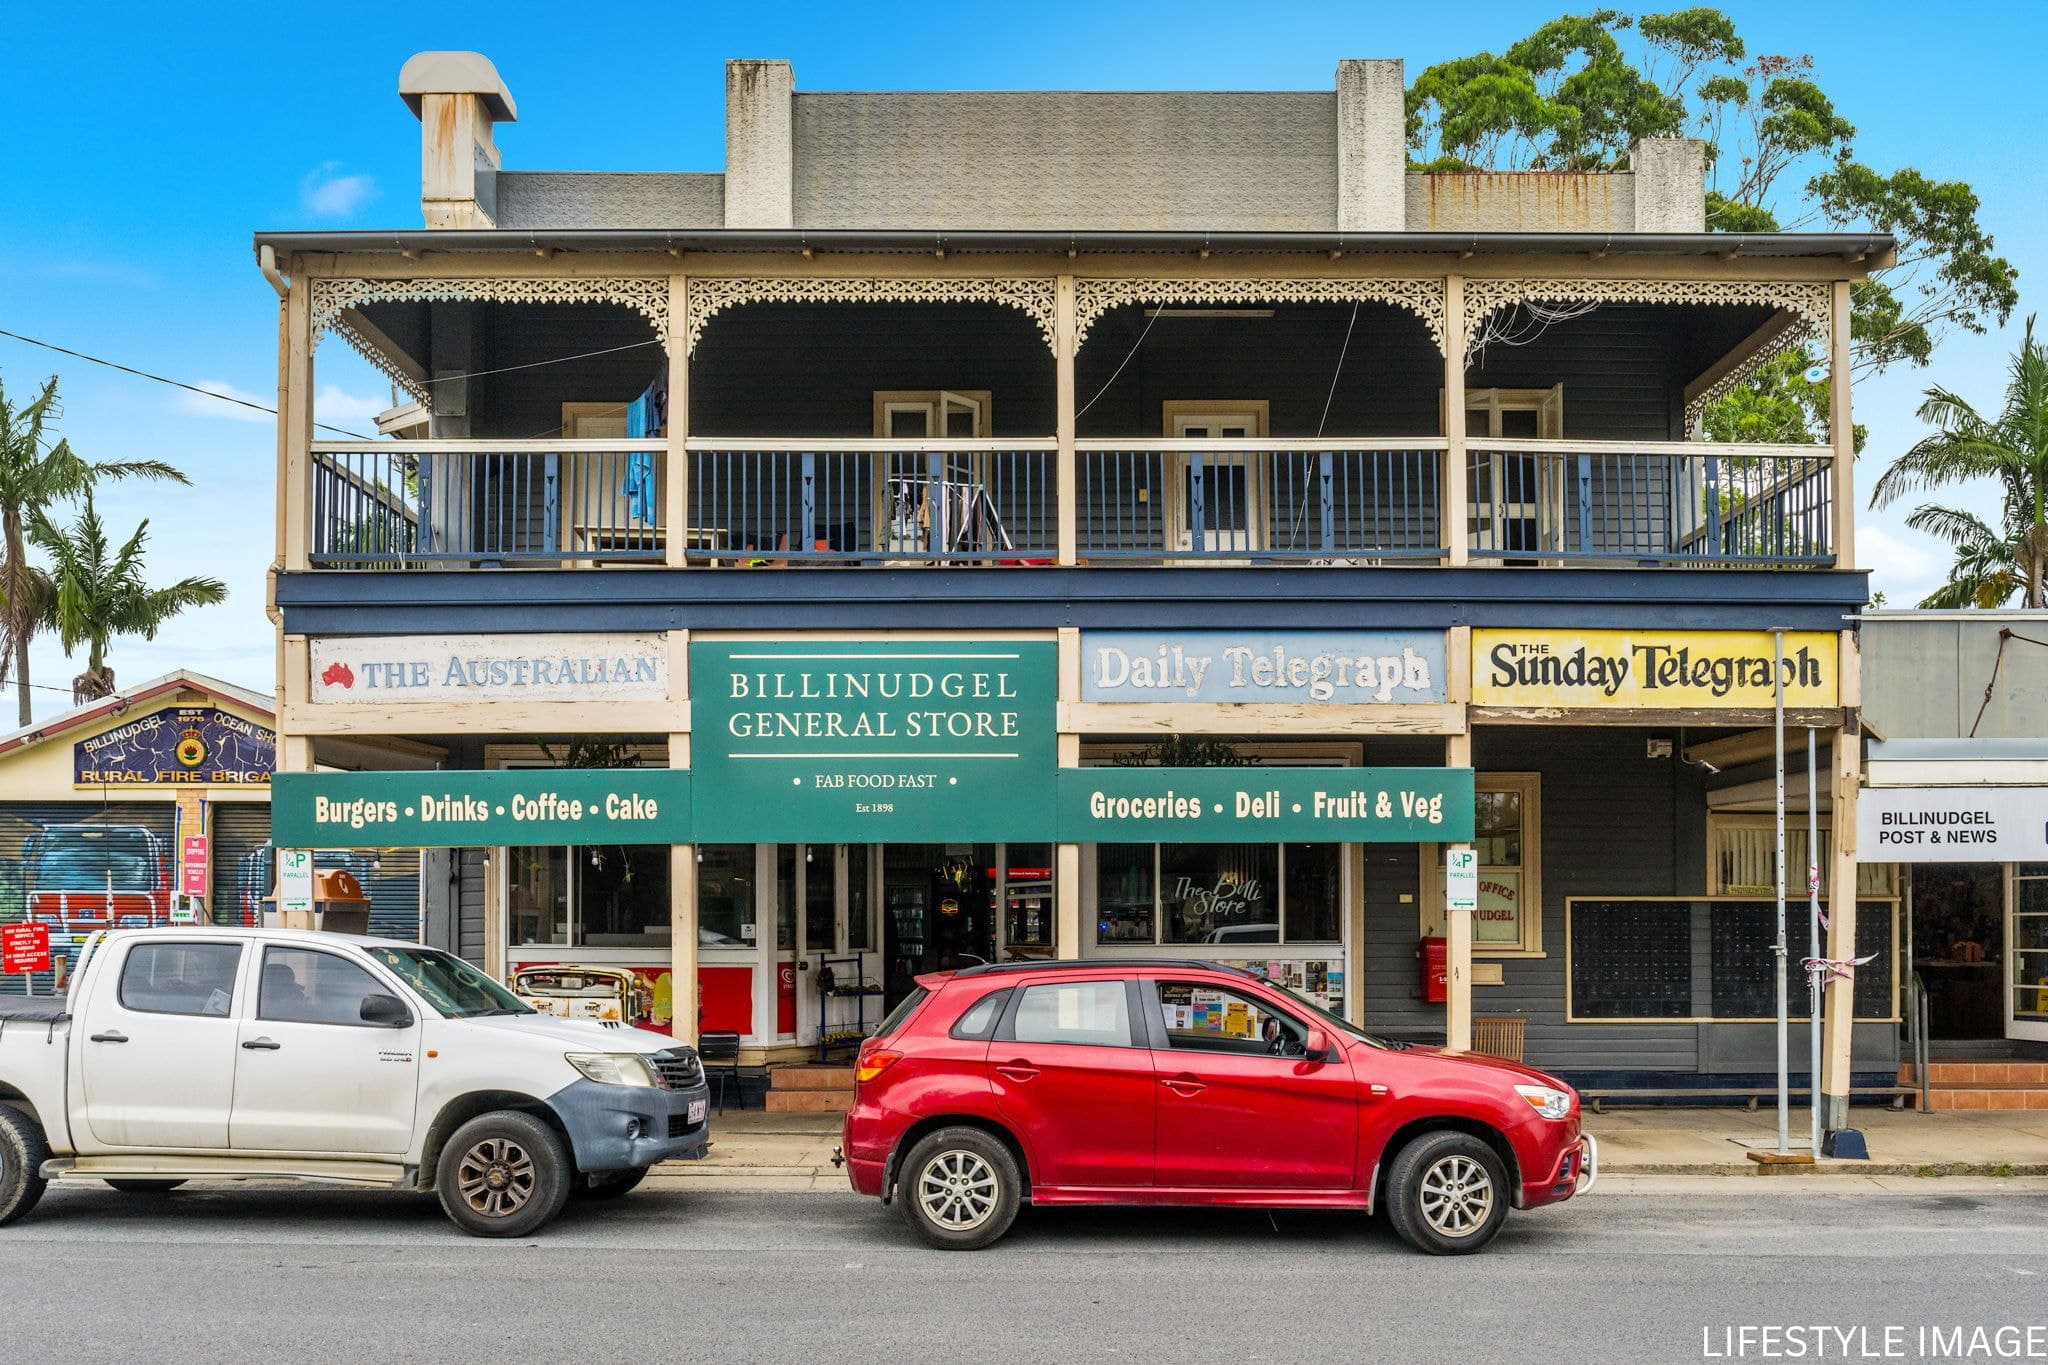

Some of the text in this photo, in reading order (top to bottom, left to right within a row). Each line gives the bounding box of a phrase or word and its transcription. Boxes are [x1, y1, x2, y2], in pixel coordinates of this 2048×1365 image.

[1520, 644, 1549, 654] THE
[362, 656, 659, 689] THE AUSTRALIAN
[1094, 645, 1431, 703] Daily Telegraph
[1491, 643, 1822, 698] Sunday Telegraph
[729, 673, 1018, 698] BILLINUDGEL
[84, 715, 166, 753] BILLINUDGEL
[213, 713, 253, 735] OCEAN
[728, 711, 1019, 738] GENERAL STORE
[81, 770, 150, 782] RURAL
[158, 771, 203, 782] FIRE
[815, 774, 937, 789] FAB FOOD FAST
[315, 792, 658, 829] Burgers Drinks Coffee Cake
[855, 803, 894, 813] Est 1898
[1090, 791, 1443, 824] Groceries Deli Fruit & Veg
[1881, 811, 1995, 826] BILLINUDGEL
[1879, 829, 1998, 845] POST & NEWS
[1175, 877, 1203, 900] The
[1479, 881, 1515, 901] OFFICE
[1193, 891, 1247, 916] Store
